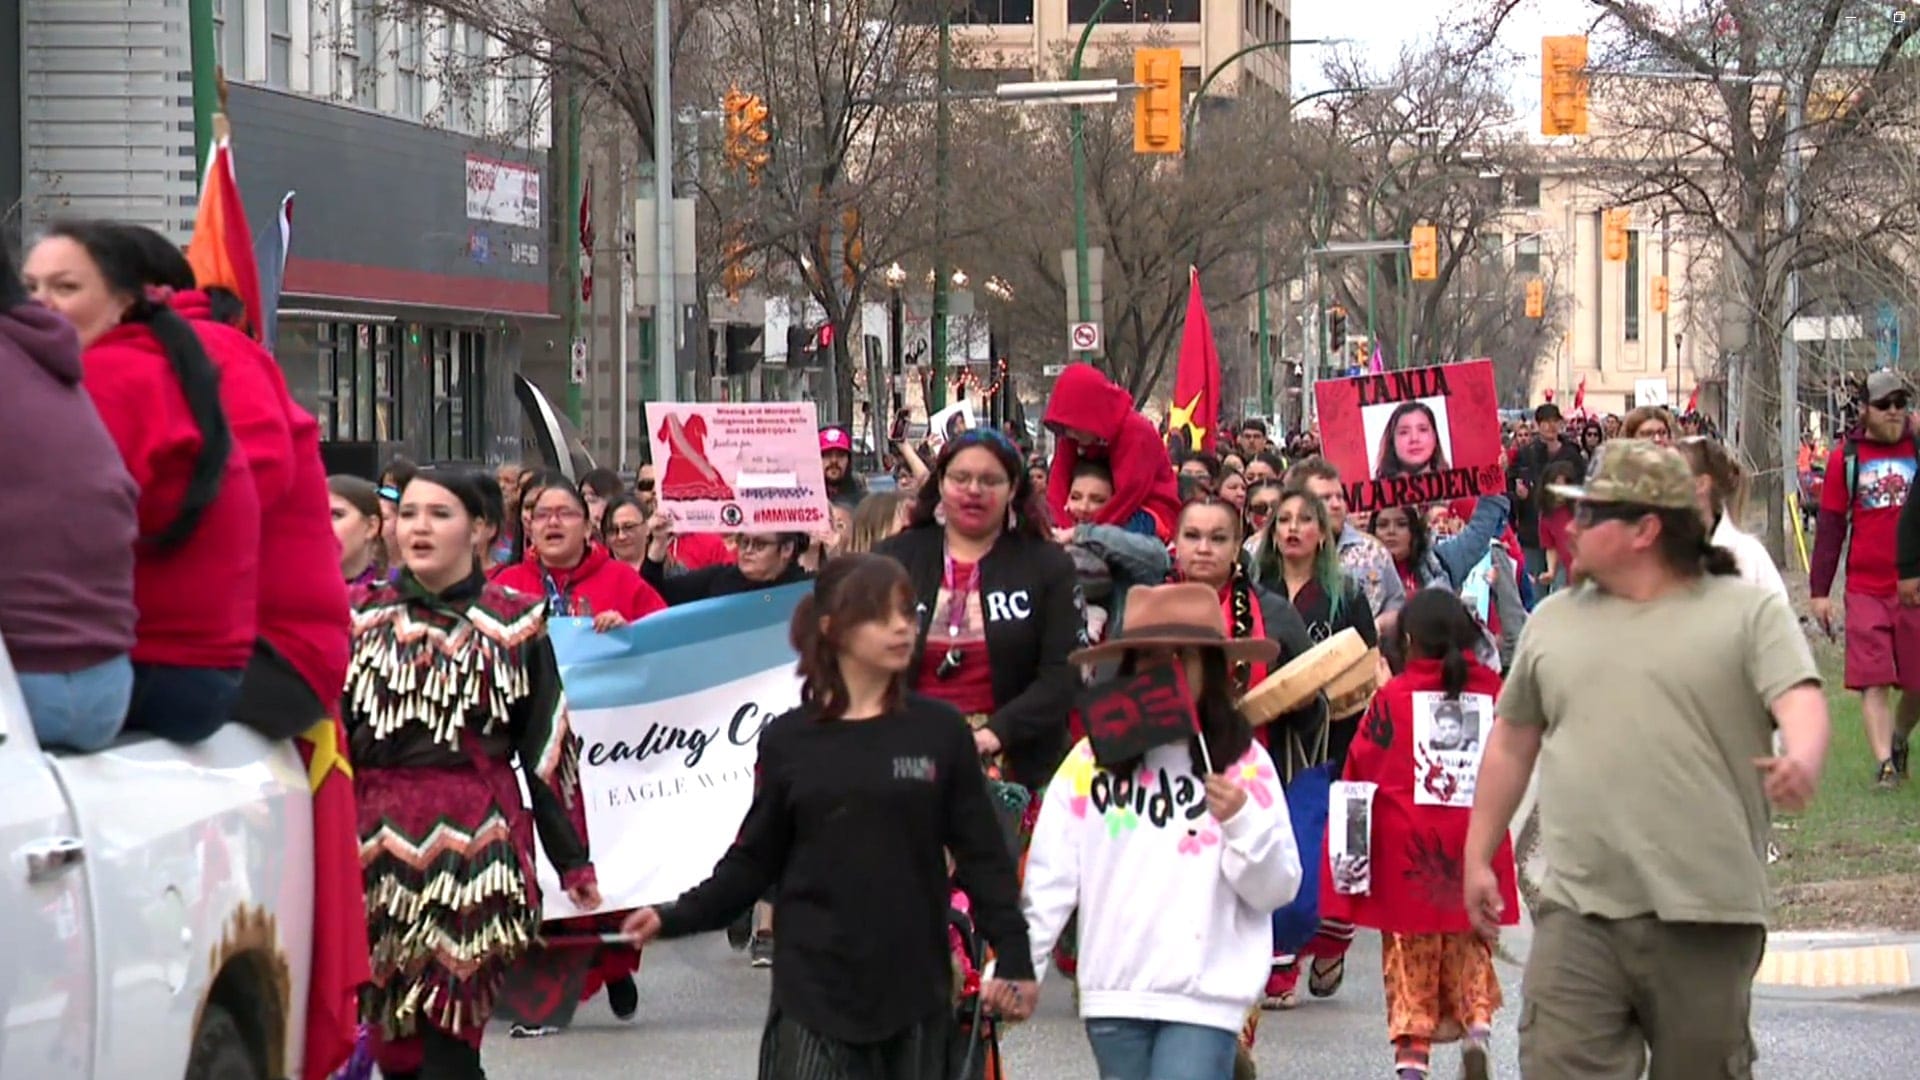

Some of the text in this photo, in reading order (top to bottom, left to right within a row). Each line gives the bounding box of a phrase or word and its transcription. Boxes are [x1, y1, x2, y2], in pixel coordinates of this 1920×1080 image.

[1351, 367, 1451, 407] TANIA
[1342, 466, 1481, 512] MARSDEN
[987, 589, 1031, 622] RC
[608, 775, 688, 807] EAGLE
